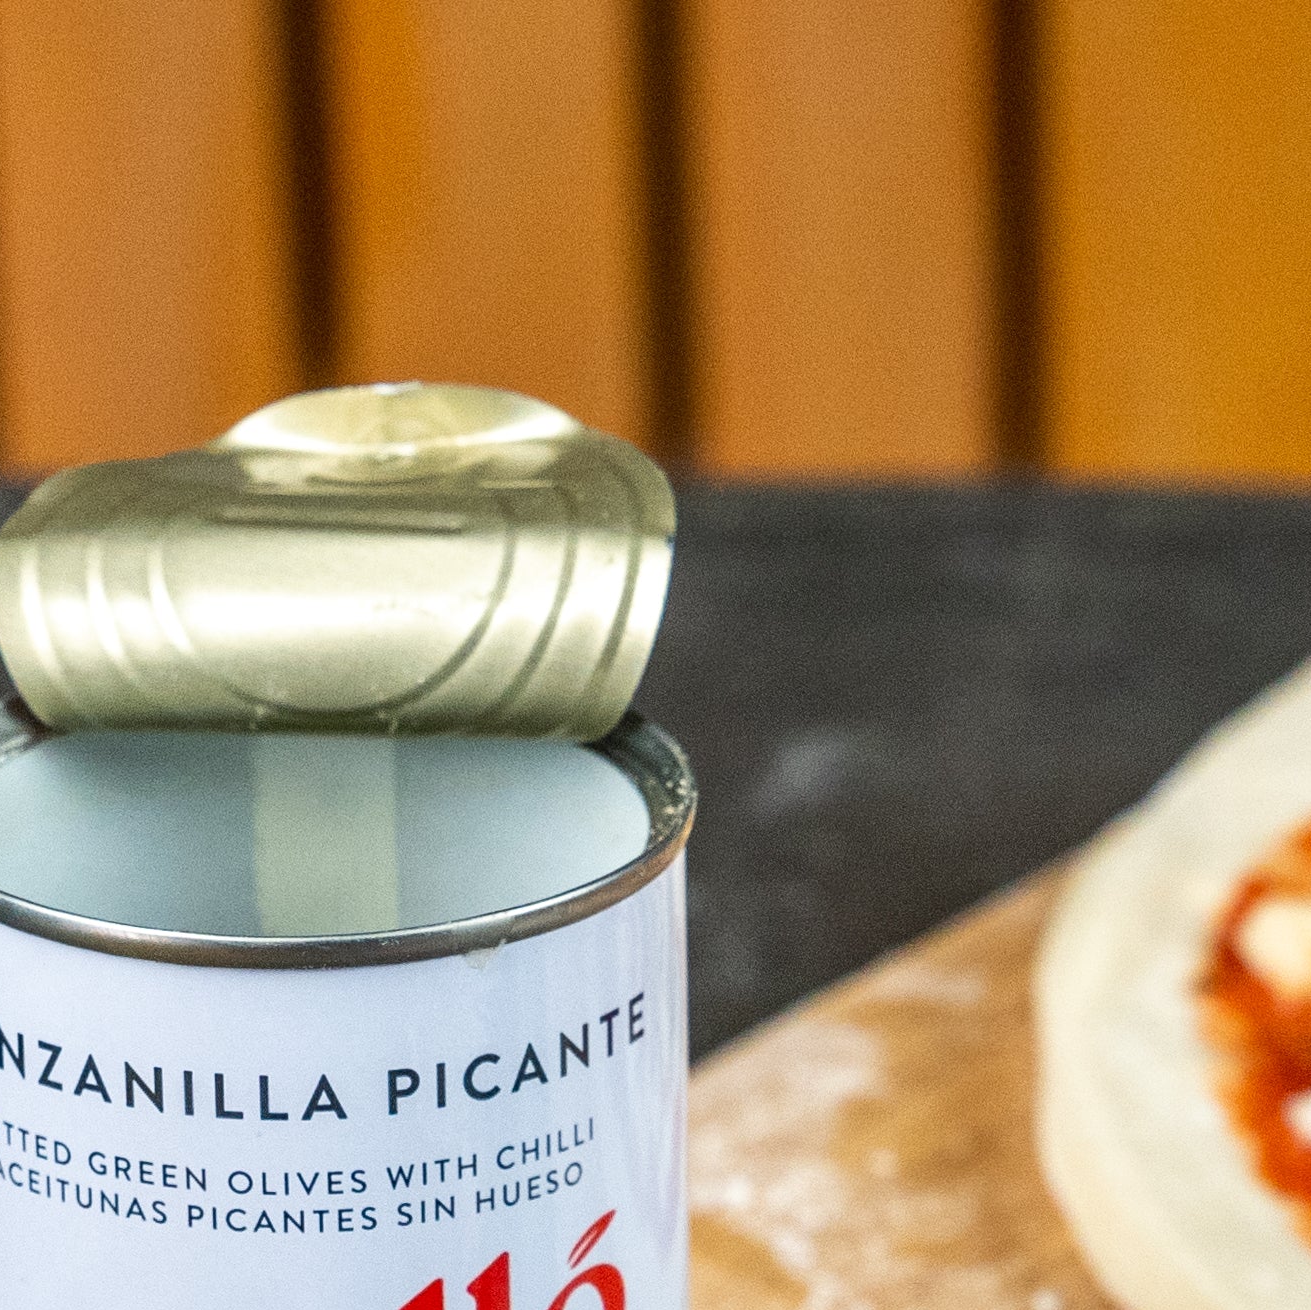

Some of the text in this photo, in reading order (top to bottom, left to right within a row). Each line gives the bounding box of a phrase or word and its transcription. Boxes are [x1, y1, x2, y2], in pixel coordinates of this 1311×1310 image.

[387, 992, 647, 1115] PICANTE
[88, 1150, 209, 1193] GREEN
[228, 1168, 368, 1197] OLIVES
[386, 1153, 479, 1191] WITH
[496, 1117, 596, 1171] CHILLI
[187, 1205, 378, 1235] PICANTES
[396, 1194, 456, 1227] SIN
[475, 1159, 585, 1215] HUESO
